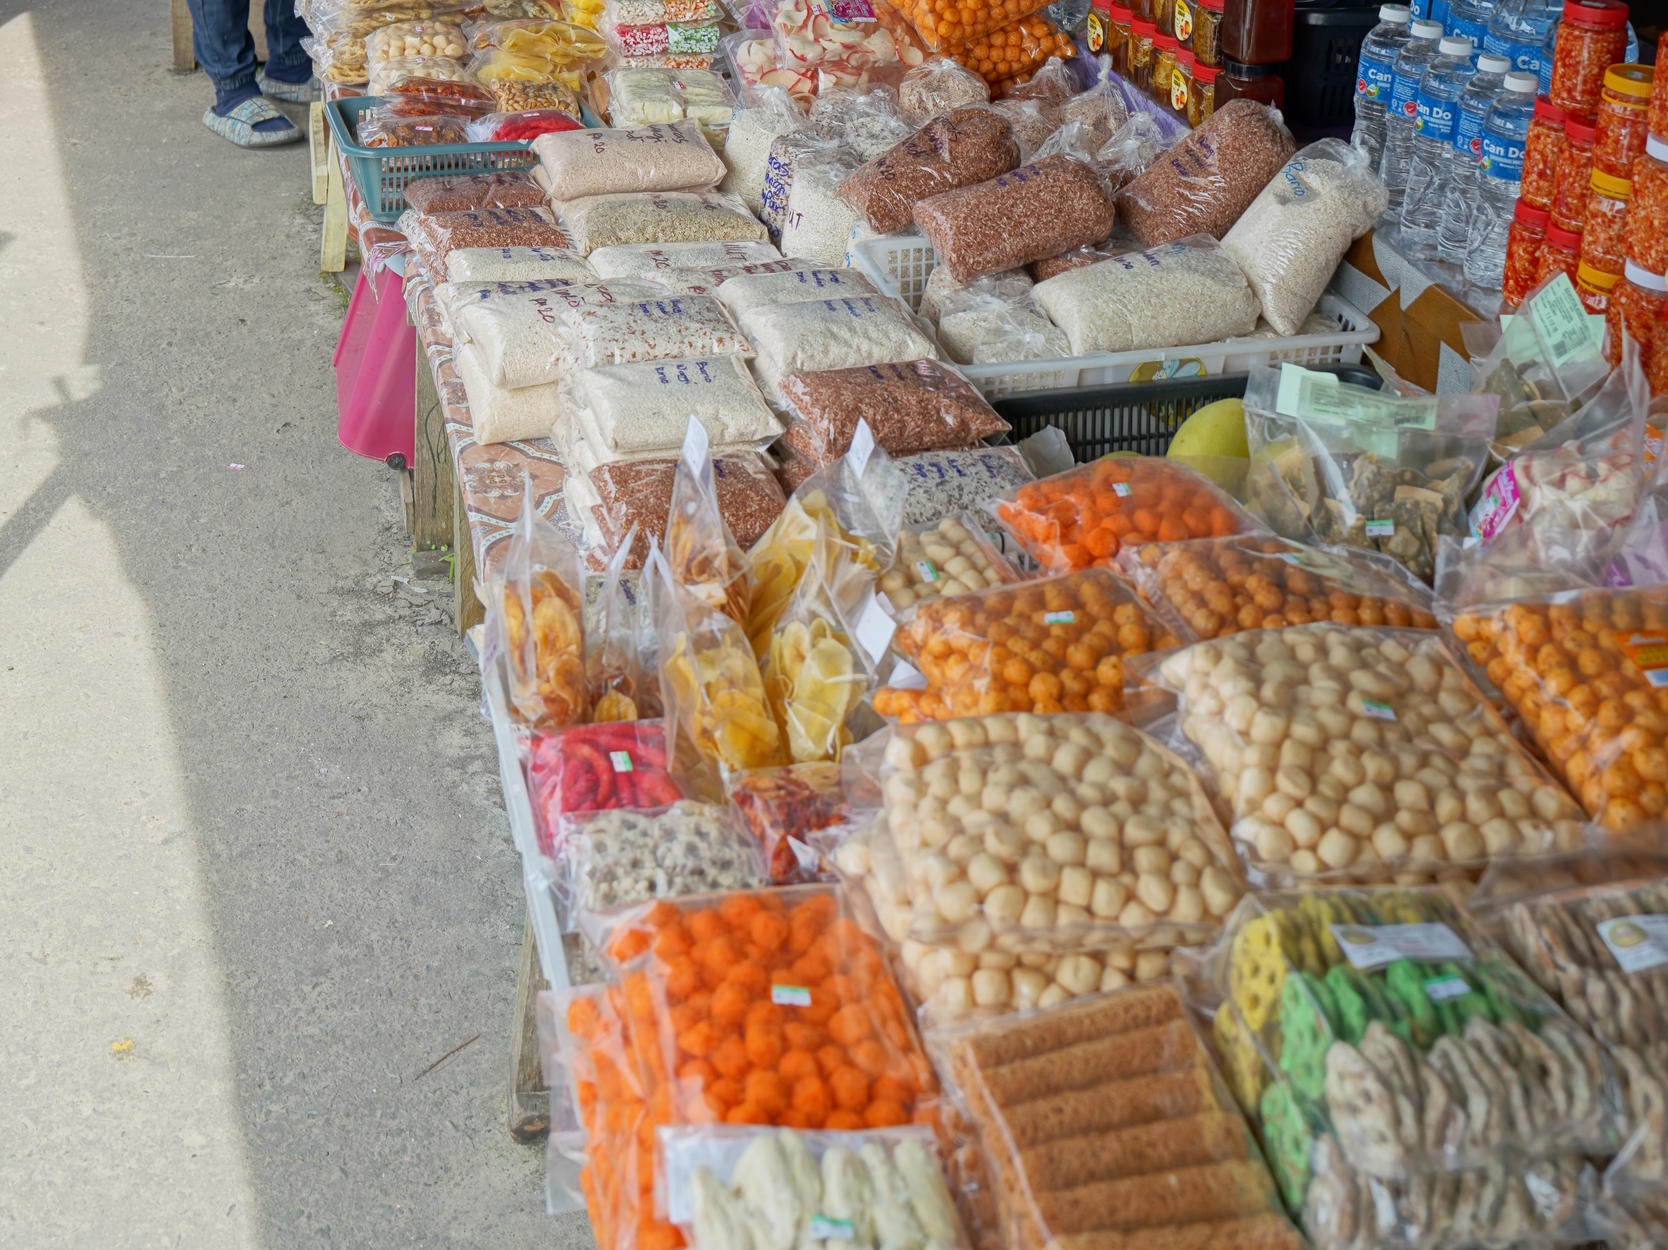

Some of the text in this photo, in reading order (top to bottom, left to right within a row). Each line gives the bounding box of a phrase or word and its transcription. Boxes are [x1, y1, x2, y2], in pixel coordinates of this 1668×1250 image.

[1517, 55, 1540, 70] Ca
[1368, 68, 1392, 83] Can
[1432, 107, 1452, 120] Do
[594, 141, 606, 154] 20
[1483, 139, 1505, 156] Can
[1281, 161, 1306, 198] Bario
[538, 306, 556, 324] 20
[695, 361, 712, 384] Bario
